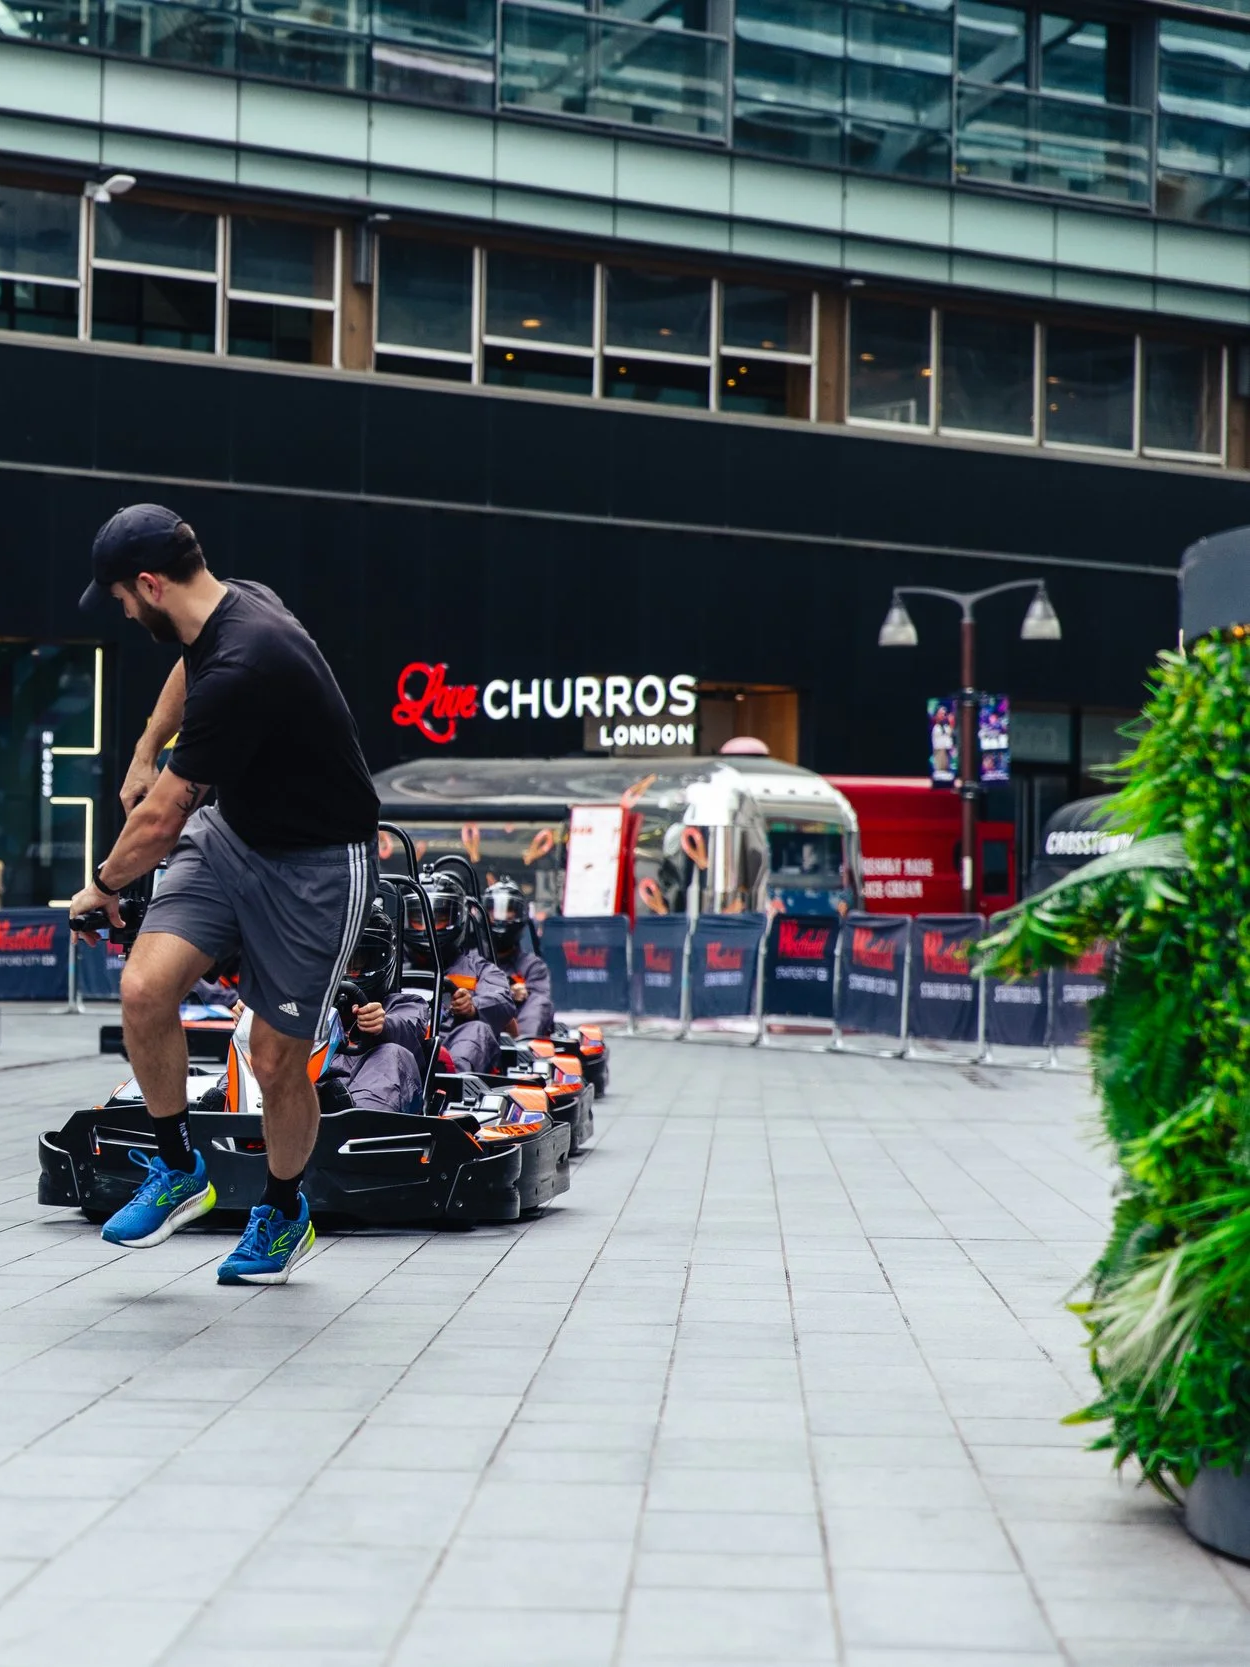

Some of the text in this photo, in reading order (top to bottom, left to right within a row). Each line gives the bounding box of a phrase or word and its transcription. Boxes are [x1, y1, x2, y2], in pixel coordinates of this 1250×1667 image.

[391, 661, 698, 744] Love CHURROS
[599, 723, 695, 747] LONDON
